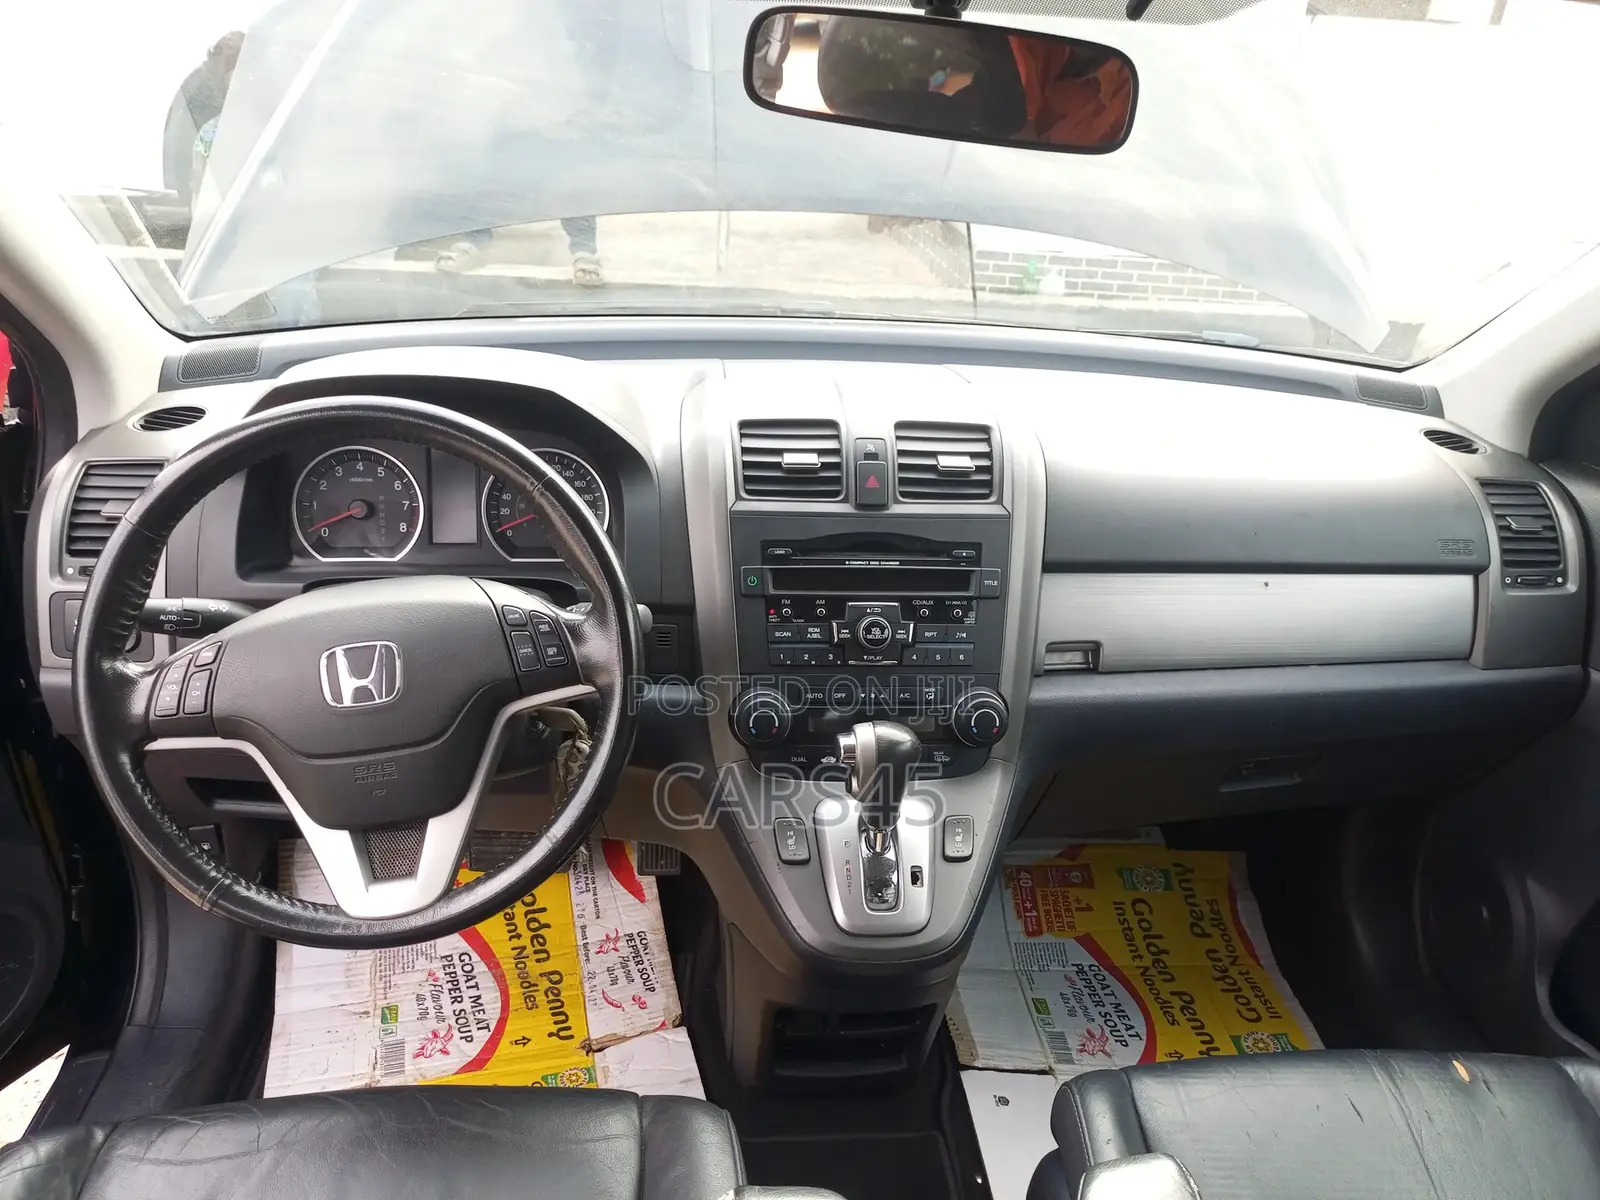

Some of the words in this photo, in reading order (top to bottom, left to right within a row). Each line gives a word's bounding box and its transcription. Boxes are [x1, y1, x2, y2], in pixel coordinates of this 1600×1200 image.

[320, 481, 328, 490] 2
[335, 467, 343, 477] 3
[356, 462, 364, 471] 4
[377, 467, 385, 477] 5
[394, 481, 402, 491] 6
[313, 500, 317, 510] 1
[402, 501, 410, 510] 7
[321, 527, 329, 537] 0
[399, 522, 407, 533] 8
[1018, 871, 1032, 887] 40
[1039, 889, 1050, 908] FREE
[592, 897, 601, 920] CARTON
[1172, 862, 1213, 938] Penny
[503, 905, 523, 942] tant
[580, 924, 588, 941] Best
[1206, 898, 1245, 966] Noodles
[458, 952, 479, 991] GOAT
[511, 945, 540, 1011] Noodles
[520, 892, 551, 963] olden
[539, 970, 575, 1041] Penny
[624, 932, 644, 967] PEPPER
[638, 967, 656, 993] SOUP
[1112, 901, 1145, 962] Instant
[1136, 966, 1181, 1026] Noodles
[1131, 898, 1176, 983] Golden
[1169, 991, 1220, 1056] Penny
[428, 983, 447, 1025] Flavour
[440, 953, 464, 1006] PEPPER
[453, 1008, 474, 1044] SOUP
[1067, 985, 1097, 1024] Flavour
[1088, 963, 1117, 1000] GOAT
[1109, 1001, 1143, 1041] MEAT
[1205, 948, 1262, 1023] Golden
[1238, 969, 1283, 1019] Instant
[416, 993, 430, 1021] 40x70g
[468, 994, 491, 1033] MEAT
[1071, 963, 1106, 1008] PEPPER
[1098, 1011, 1129, 1048] SOUP
